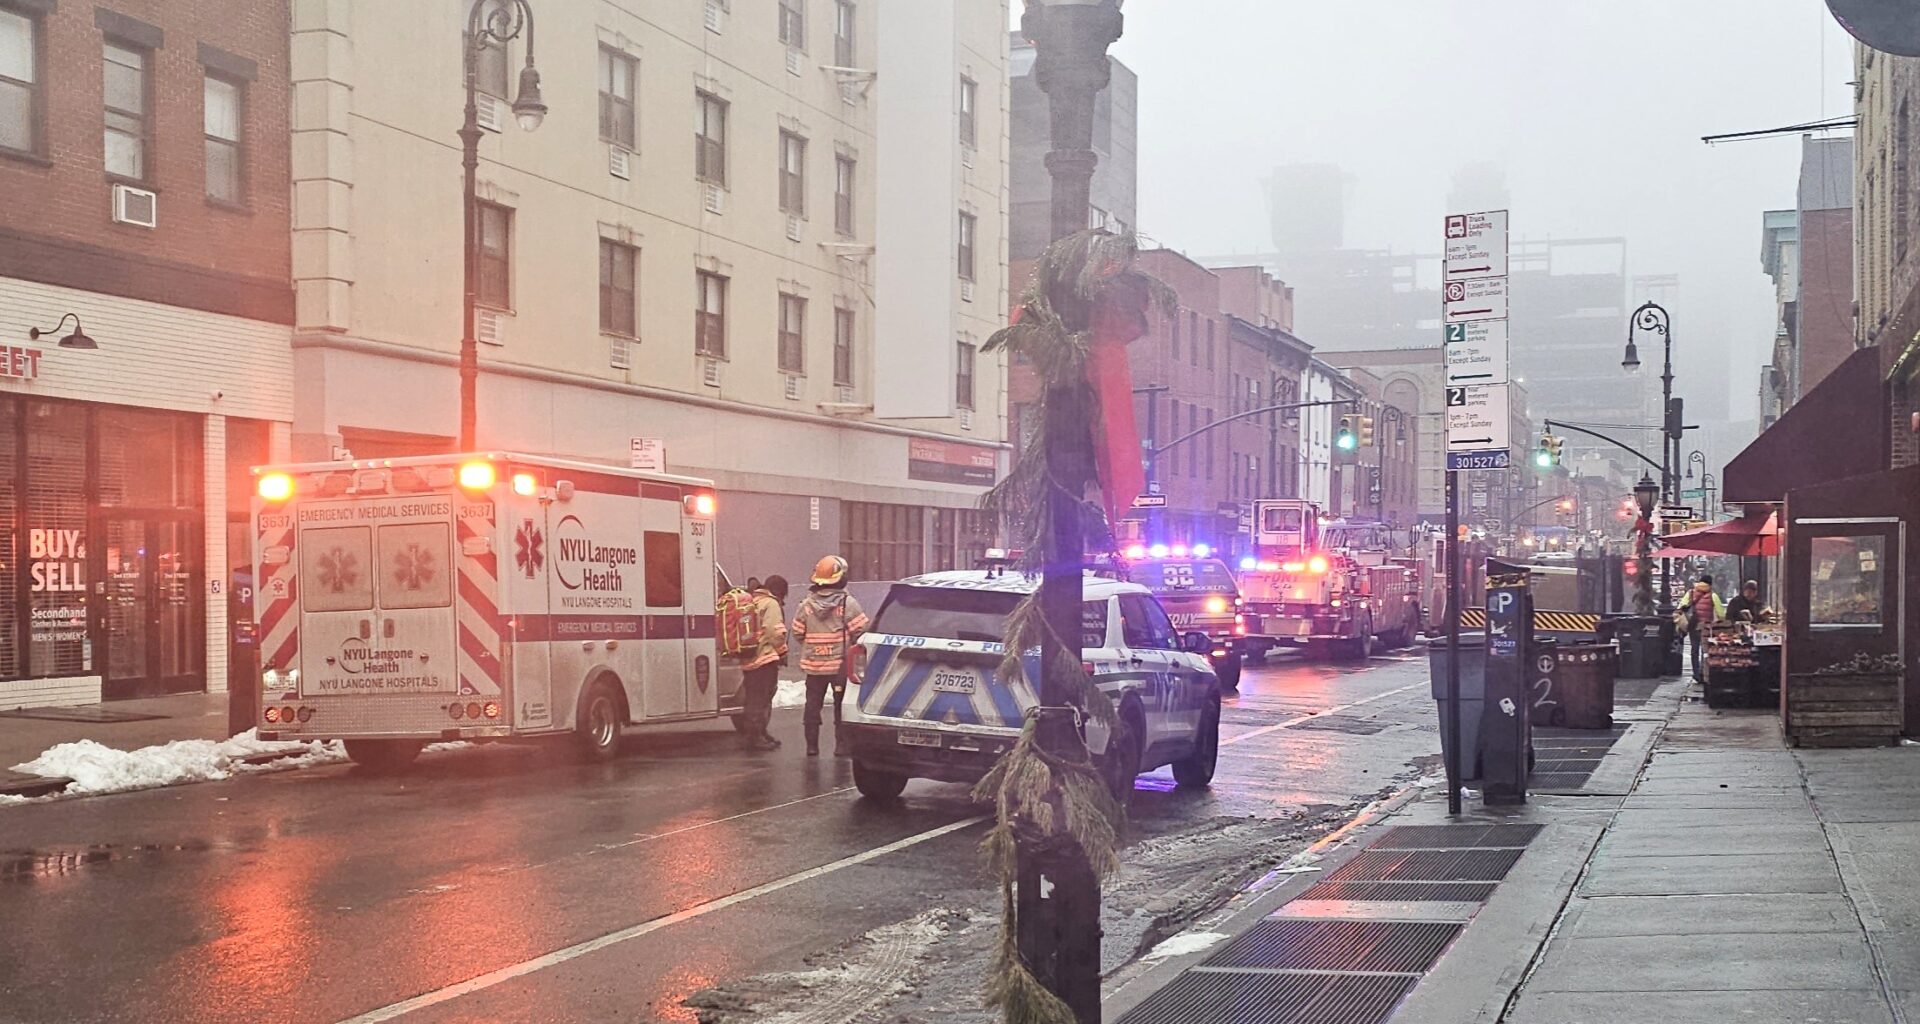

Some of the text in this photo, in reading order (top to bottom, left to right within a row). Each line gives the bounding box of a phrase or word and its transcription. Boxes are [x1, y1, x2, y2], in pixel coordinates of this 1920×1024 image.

[1469, 215, 1485, 223] Truck
[1469, 222, 1492, 230] Loading
[1469, 251, 1489, 259] Sunday
[1450, 324, 1461, 341] 2
[1467, 335, 1487, 343] parking
[1451, 388, 1462, 405] 2
[1465, 412, 1479, 420] 7pm
[1450, 420, 1493, 429] Except Sunday
[1456, 456, 1494, 469] 301527
[300, 503, 450, 522] EMERGENCY MEDICAL SERVICES
[460, 503, 491, 518] 3637
[262, 516, 291, 529] 3637
[690, 522, 706, 536] 3637
[29, 528, 86, 559] BUY &
[560, 538, 636, 568] NYU Langone
[31, 561, 87, 592] SELL
[583, 568, 622, 591] Health
[241, 587, 252, 603] P
[561, 596, 632, 609] NYU LANGONE HOSPITALS
[1498, 592, 1513, 614] P
[31, 606, 87, 619] Secondhand
[558, 622, 637, 633] EMERGENCY MEDICAL SERVICES
[881, 635, 926, 647] NYPD
[344, 648, 414, 663] NYU Langone
[363, 662, 400, 674] Health
[319, 676, 439, 690] NYU LANGONE HOSPITALS
[934, 674, 975, 689] 376723
[1533, 678, 1557, 708] 2
